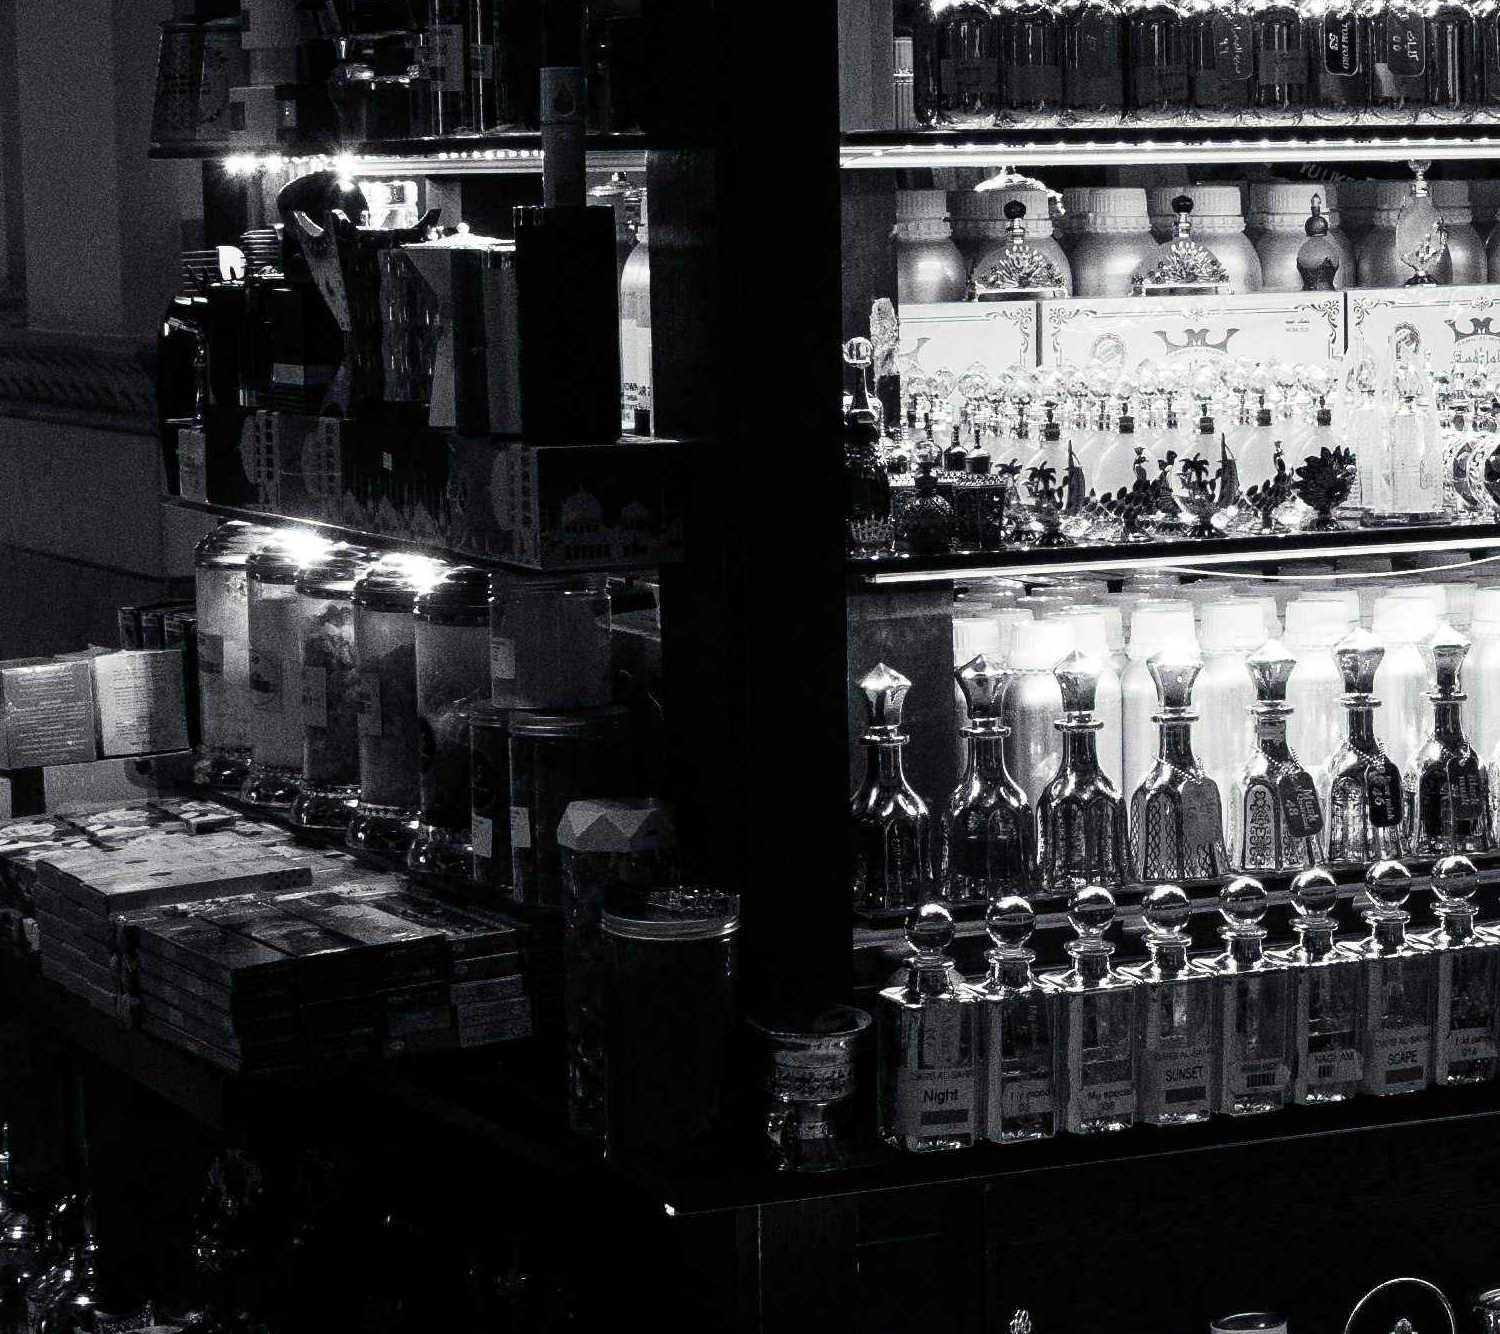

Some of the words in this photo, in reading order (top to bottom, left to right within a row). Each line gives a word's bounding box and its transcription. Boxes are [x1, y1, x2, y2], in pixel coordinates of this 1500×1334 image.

[1302, 789, 1319, 823] Musk
[1387, 1050, 1418, 1065] SCAPE
[1165, 1066, 1204, 1082] SUNSET
[923, 1088, 958, 1105] Night
